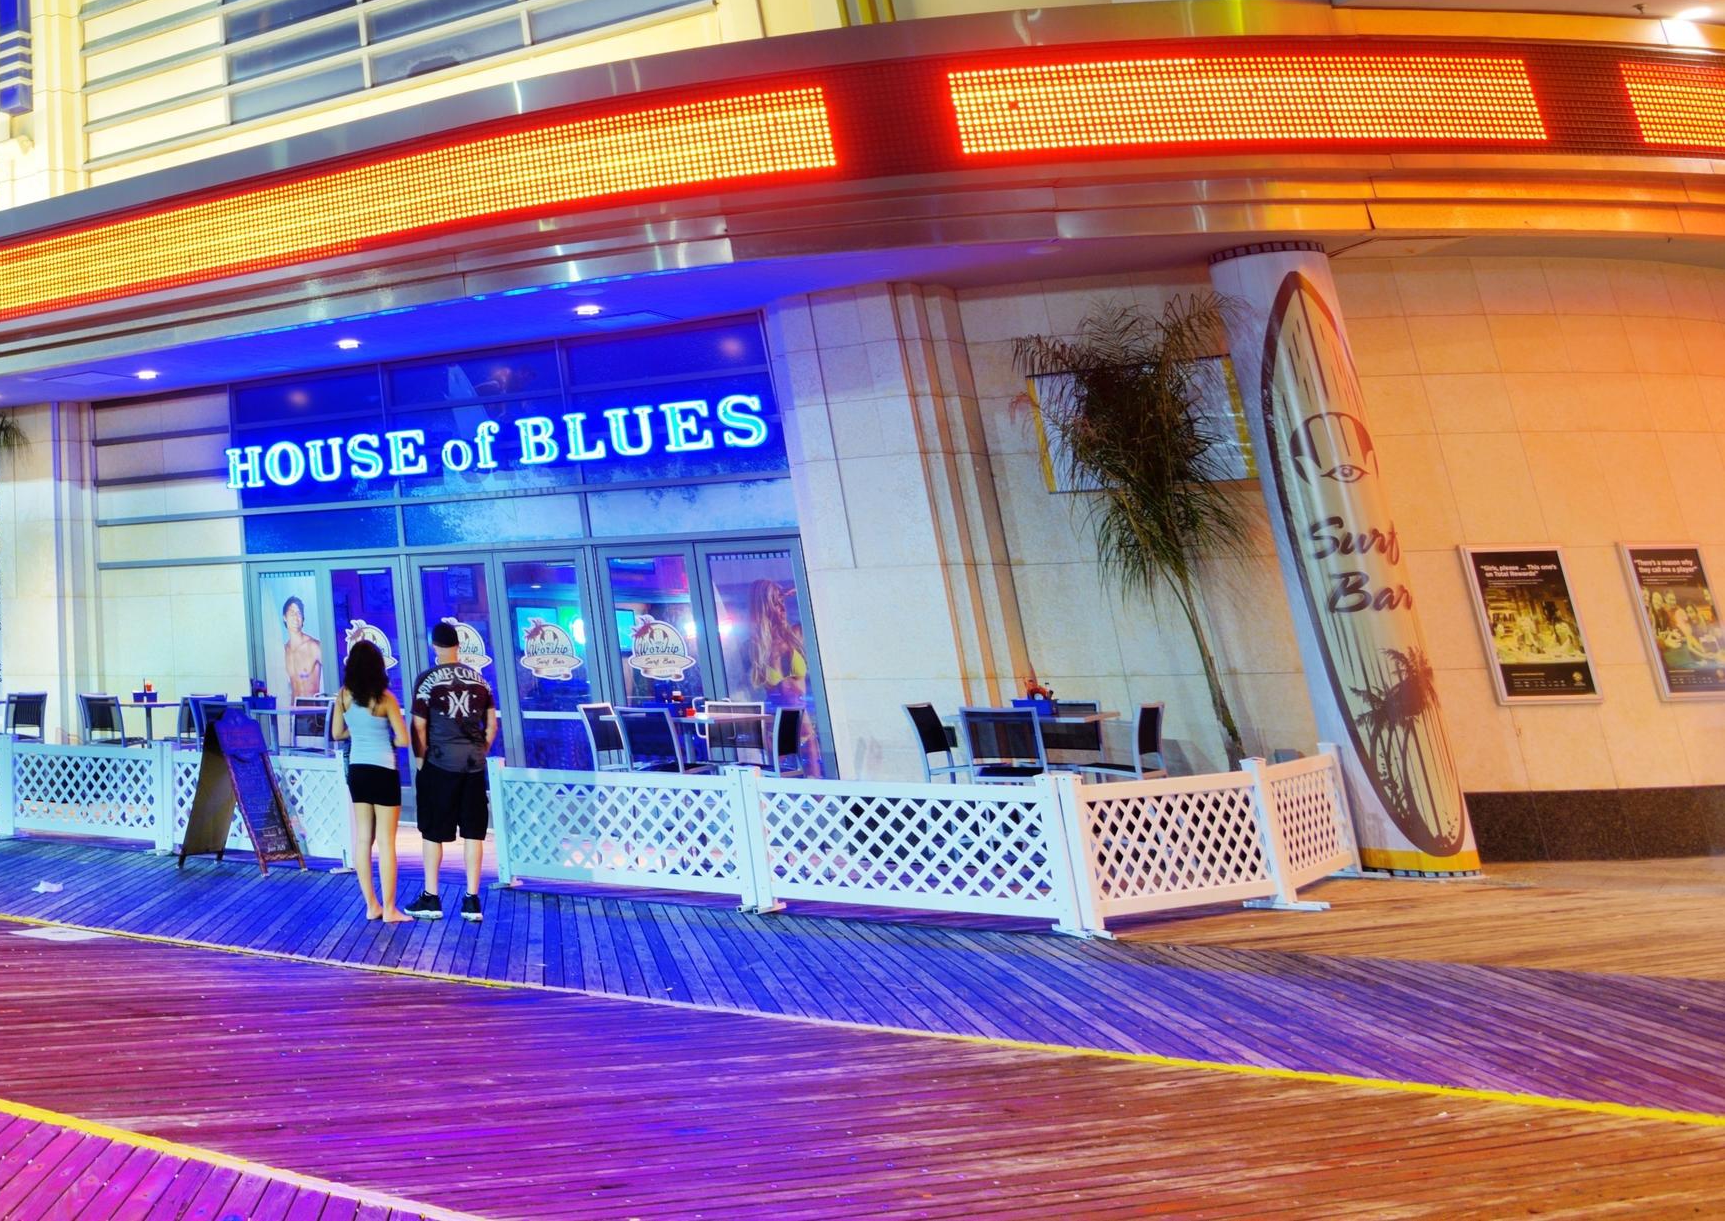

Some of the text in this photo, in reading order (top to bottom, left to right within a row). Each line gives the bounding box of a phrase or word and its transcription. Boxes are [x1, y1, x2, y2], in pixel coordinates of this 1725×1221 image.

[224, 394, 769, 489] HOUSE of BLUES
[1309, 516, 1401, 566] Surf
[1328, 571, 1413, 614] Bar
[640, 644, 679, 655] Worship
